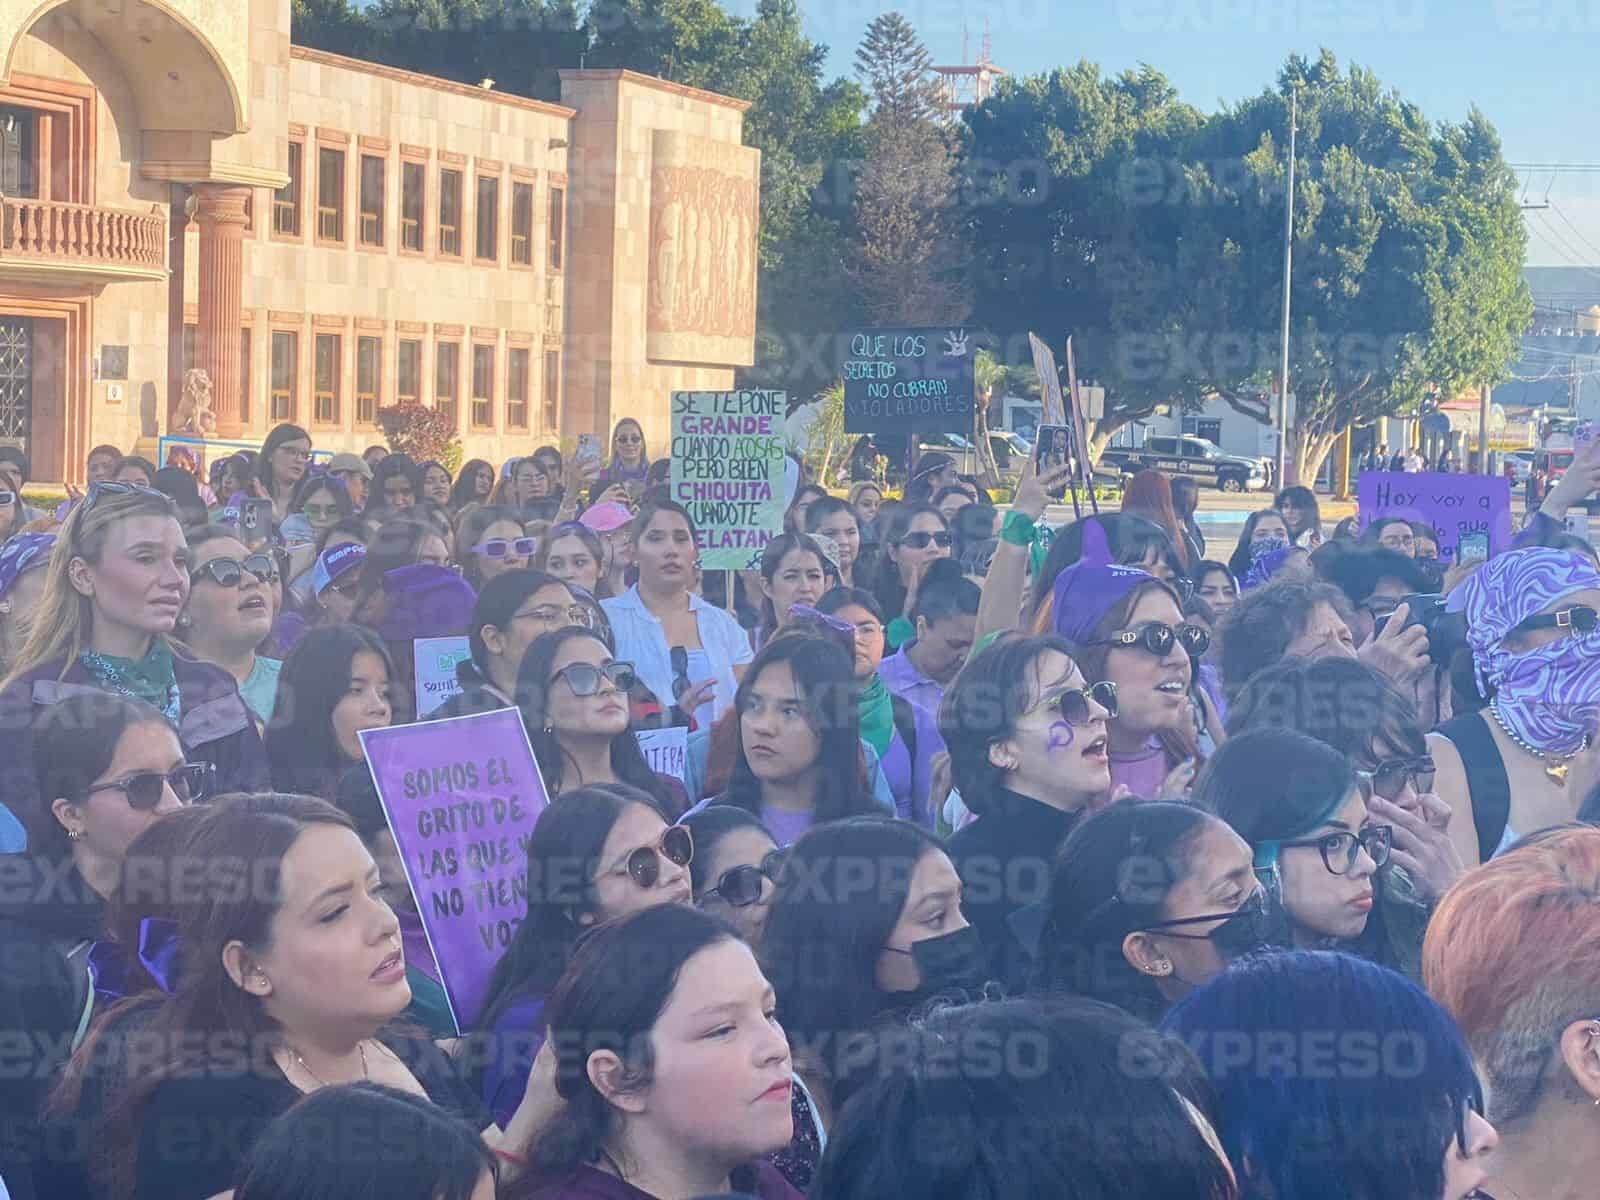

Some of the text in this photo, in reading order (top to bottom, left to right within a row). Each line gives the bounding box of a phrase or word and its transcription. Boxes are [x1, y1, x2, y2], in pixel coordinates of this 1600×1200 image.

[852, 334, 926, 358] QUE LOS
[868, 380, 948, 398] NO CUBRAN
[674, 392, 700, 414] SE
[848, 395, 969, 416] VIOLADORES
[681, 416, 772, 435] GRANDE
[672, 436, 730, 459] CUANDO
[683, 458, 769, 480] PERO BIEN
[678, 482, 772, 502] CHIQUITA
[1376, 480, 1417, 508] Hoy
[694, 529, 773, 549] ELATAN
[403, 757, 513, 800] SOMOS EL
[417, 794, 526, 839] GRITO DE
[418, 848, 459, 880] LAS
[466, 838, 515, 873] QUE
[432, 888, 465, 920] NO
